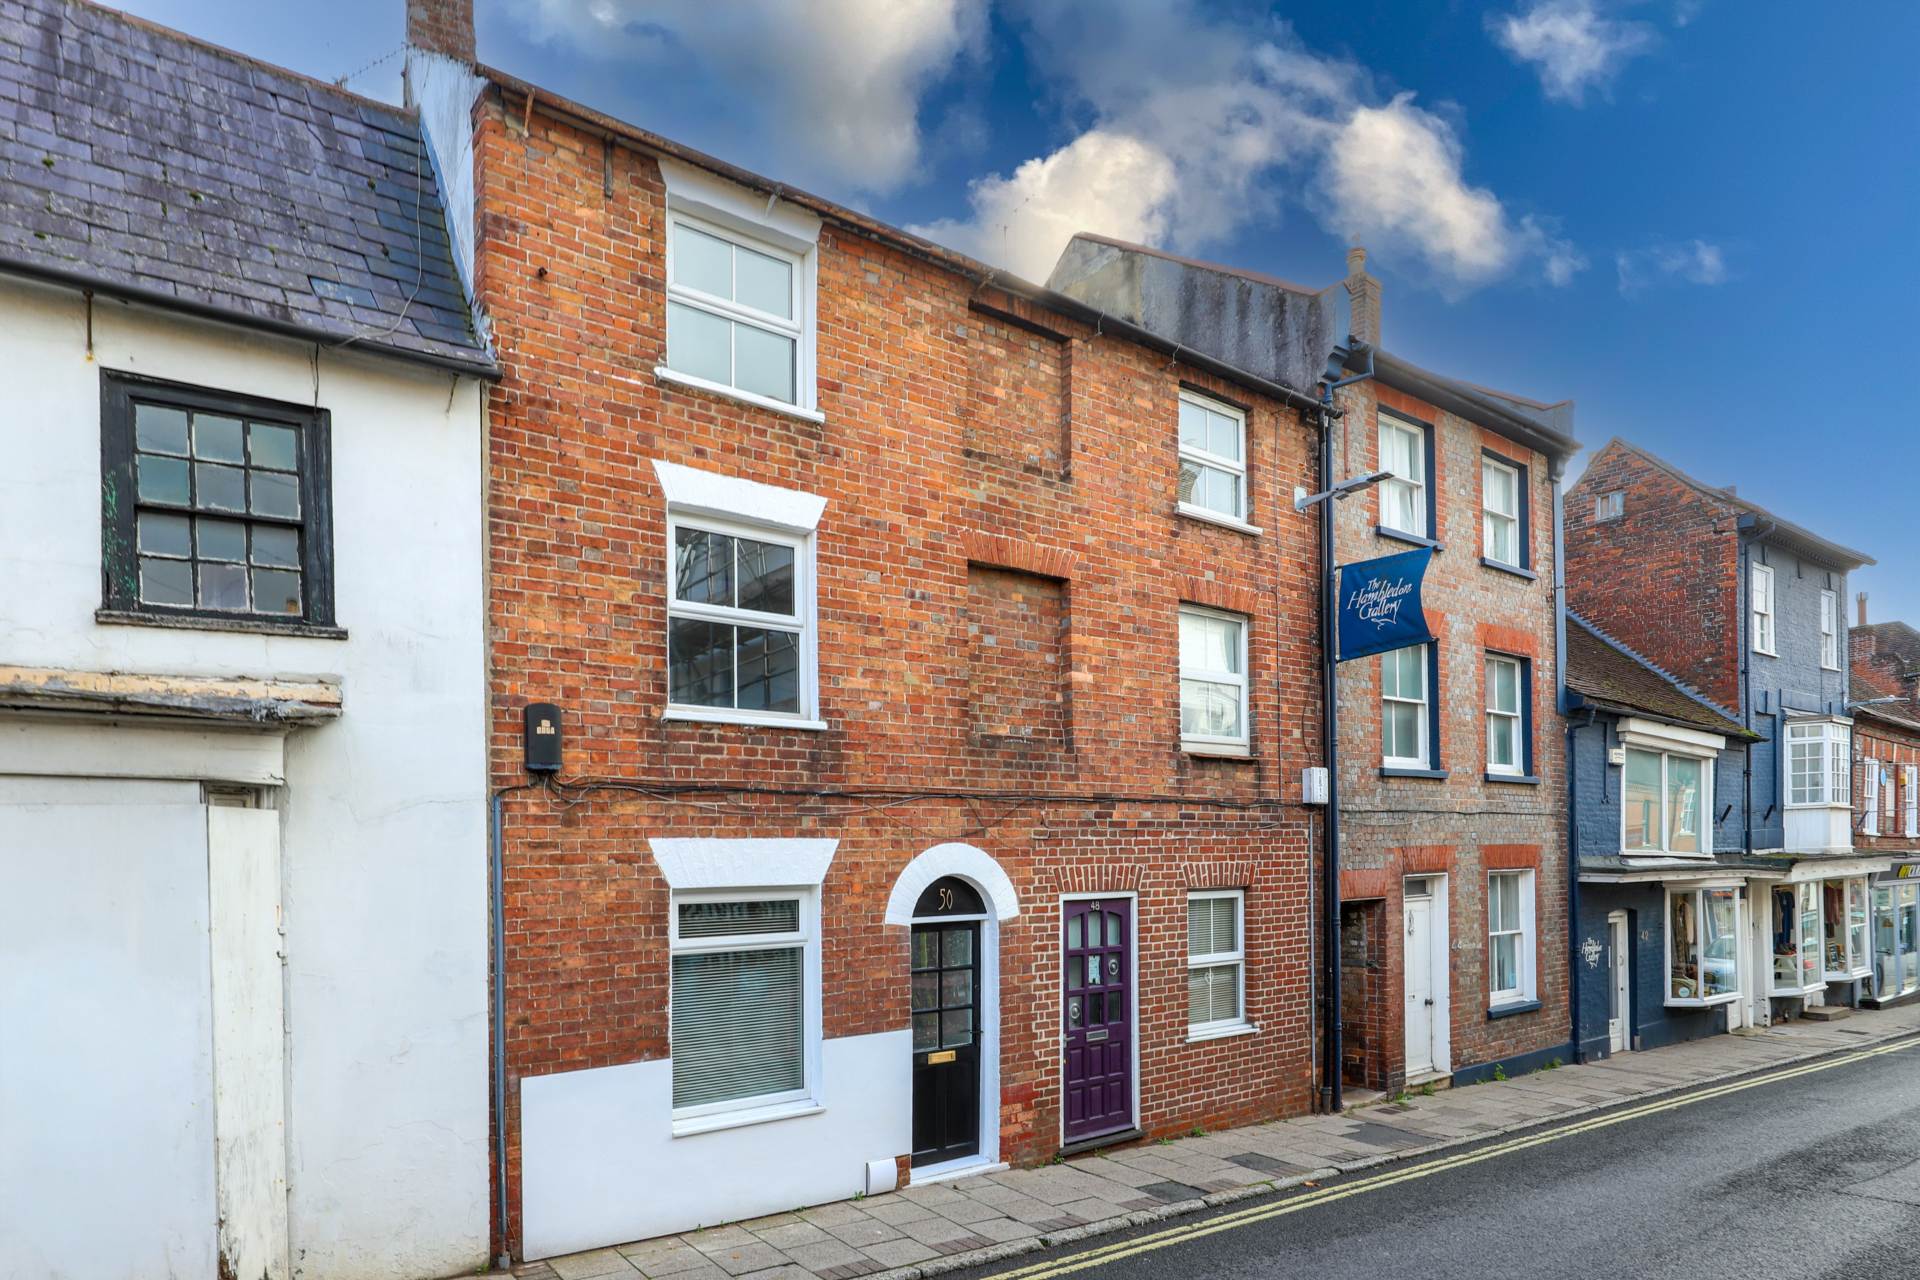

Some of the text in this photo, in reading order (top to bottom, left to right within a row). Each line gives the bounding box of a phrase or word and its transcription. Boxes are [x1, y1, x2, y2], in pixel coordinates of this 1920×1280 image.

[1346, 577, 1412, 610] Hambledon
[1368, 577, 1380, 592] The
[1359, 599, 1402, 624] Gallery
[938, 888, 953, 911] 50
[1090, 900, 1100, 911] 48
